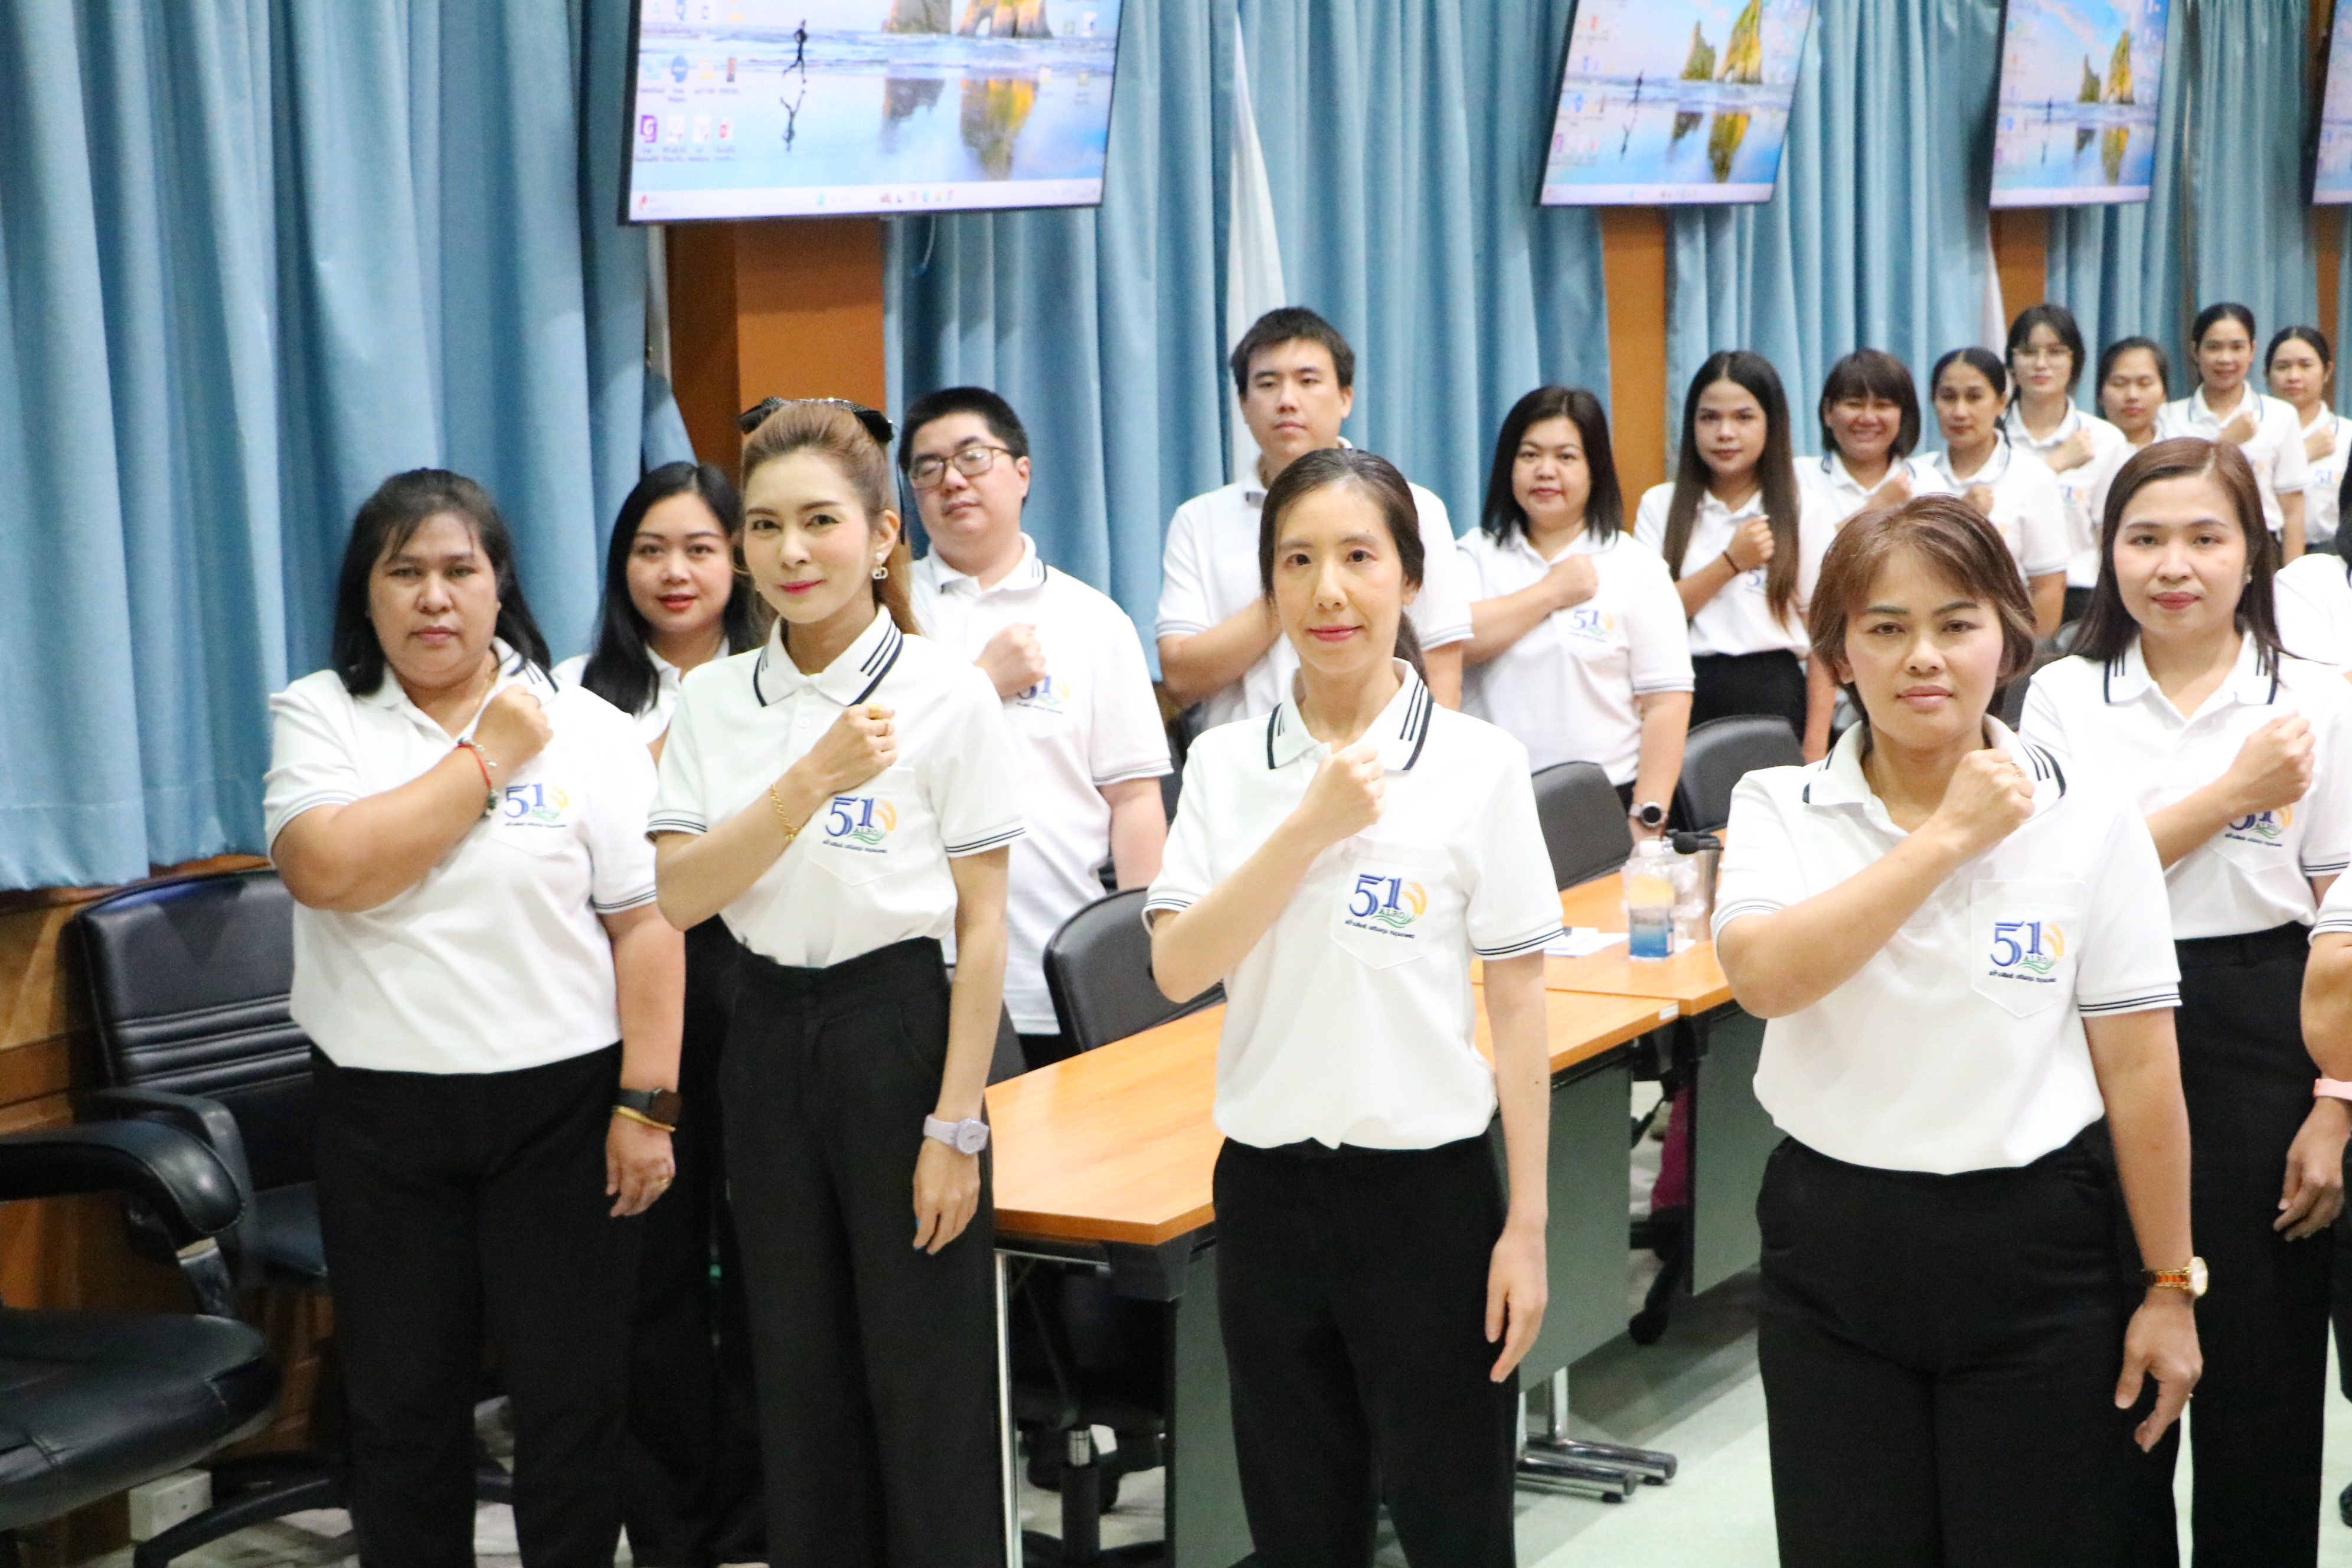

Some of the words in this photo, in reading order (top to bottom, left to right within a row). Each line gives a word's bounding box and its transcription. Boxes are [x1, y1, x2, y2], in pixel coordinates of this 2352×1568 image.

[1569, 609, 1599, 630] 51
[504, 782, 546, 818] 51
[825, 796, 875, 837] 51
[1349, 874, 1402, 917] 51
[1990, 920, 2044, 966] 51
